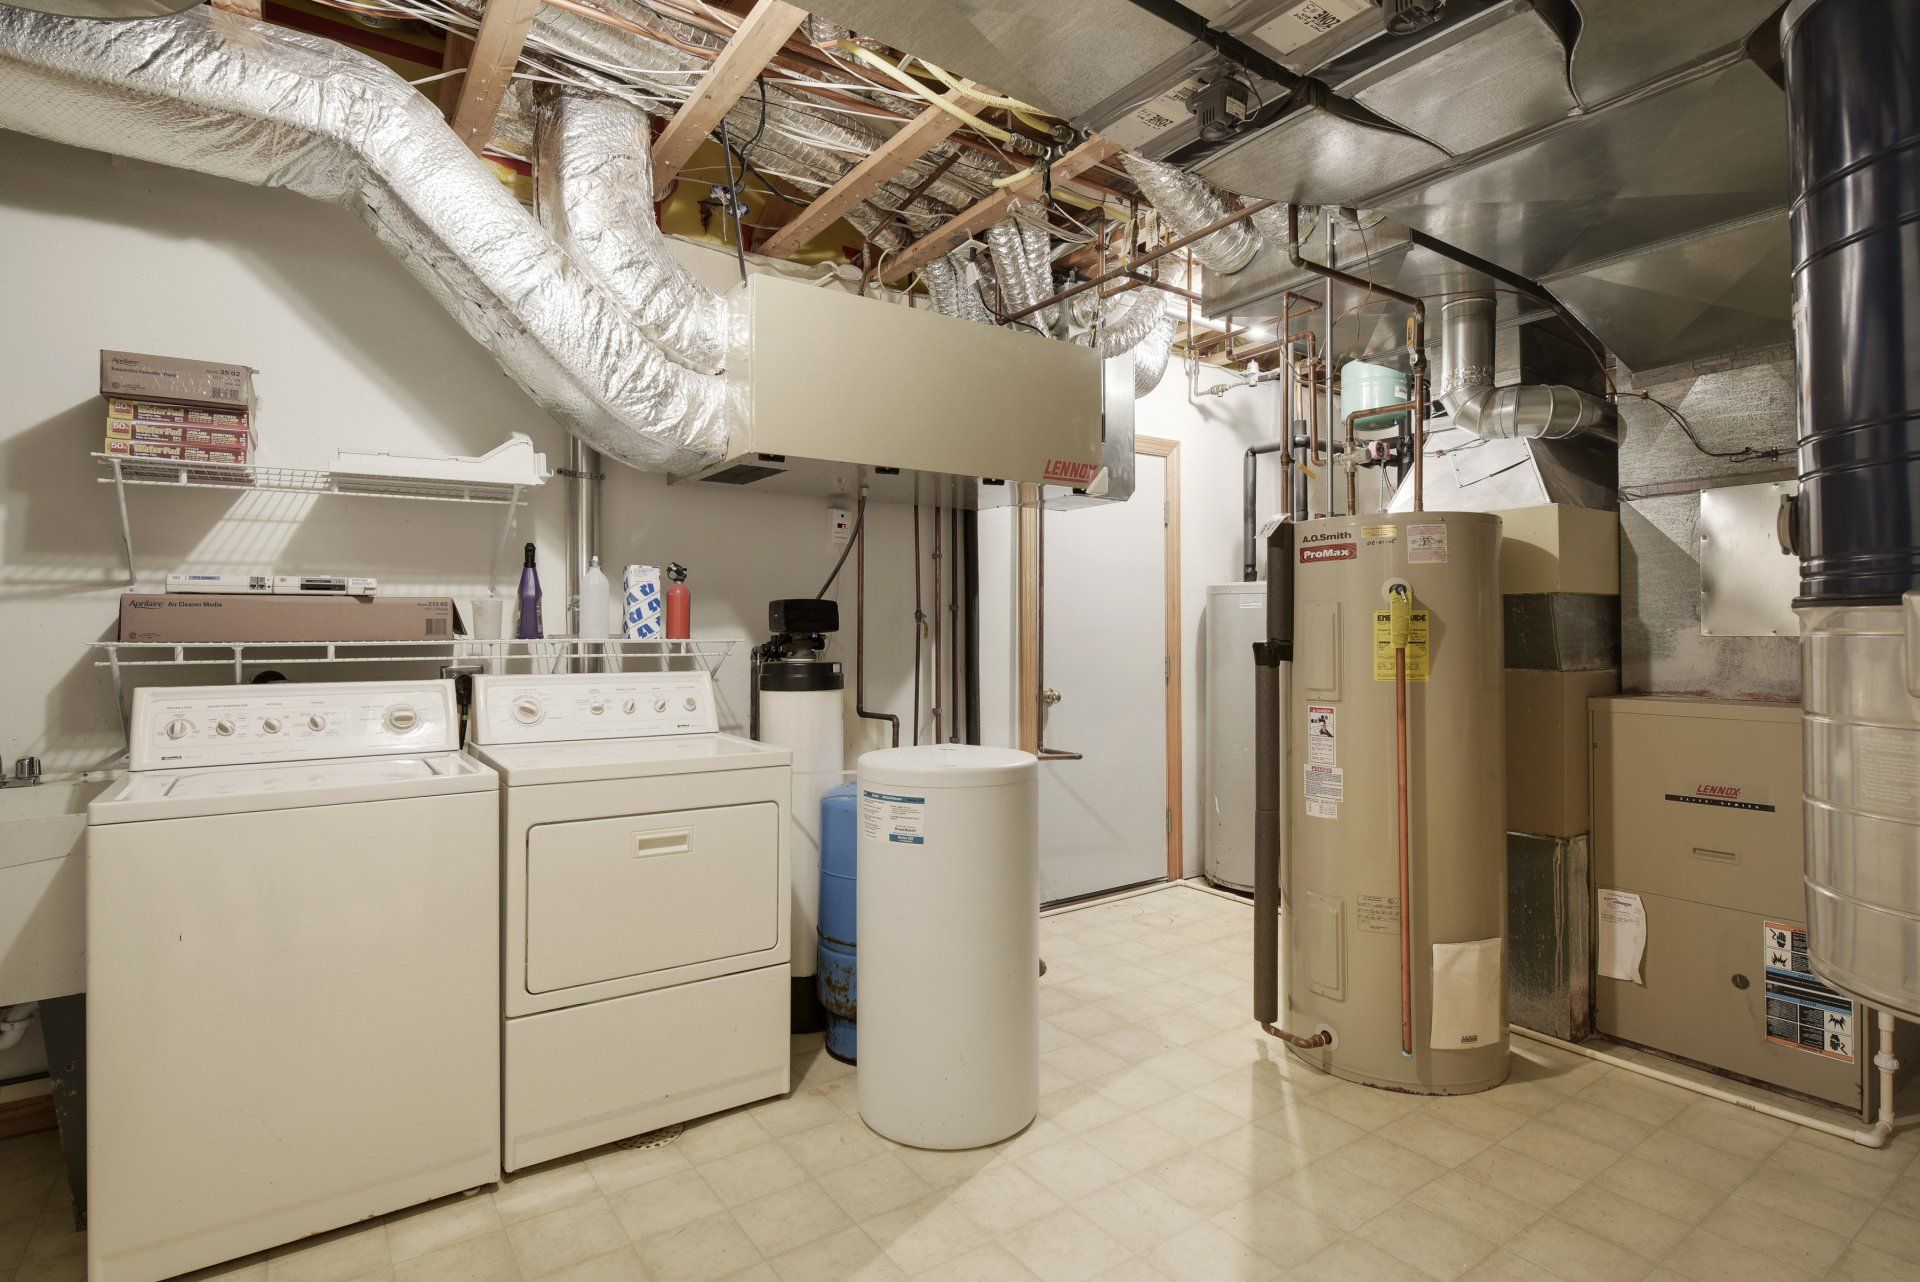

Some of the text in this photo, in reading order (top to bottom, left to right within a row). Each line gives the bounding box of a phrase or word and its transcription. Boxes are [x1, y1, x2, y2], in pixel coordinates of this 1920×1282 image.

[1313, 10, 1341, 28] ZONE
[1043, 459, 1098, 480] LENNOX
[1303, 531, 1352, 543] A.O.Smith
[1304, 548, 1350, 560] ProMax
[128, 600, 164, 609] Aprilaire
[1697, 784, 1740, 797] LENNOX
